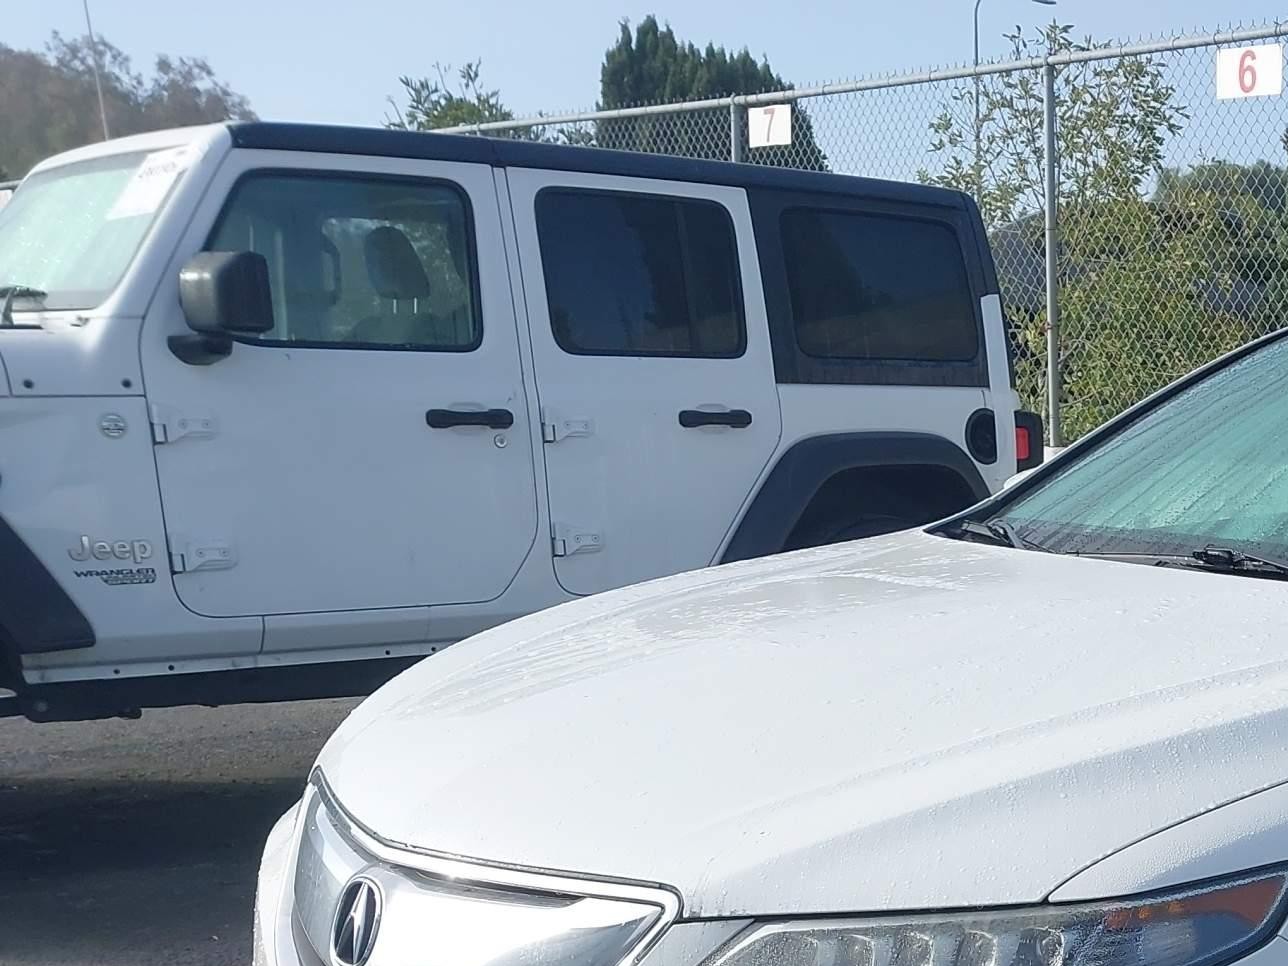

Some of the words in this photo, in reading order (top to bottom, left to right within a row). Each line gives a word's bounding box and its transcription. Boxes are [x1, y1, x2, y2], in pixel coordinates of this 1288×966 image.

[1237, 49, 1258, 94] 6
[762, 107, 776, 143] 7
[69, 534, 152, 564] Jeep
[73, 568, 155, 578] WRANGLER
